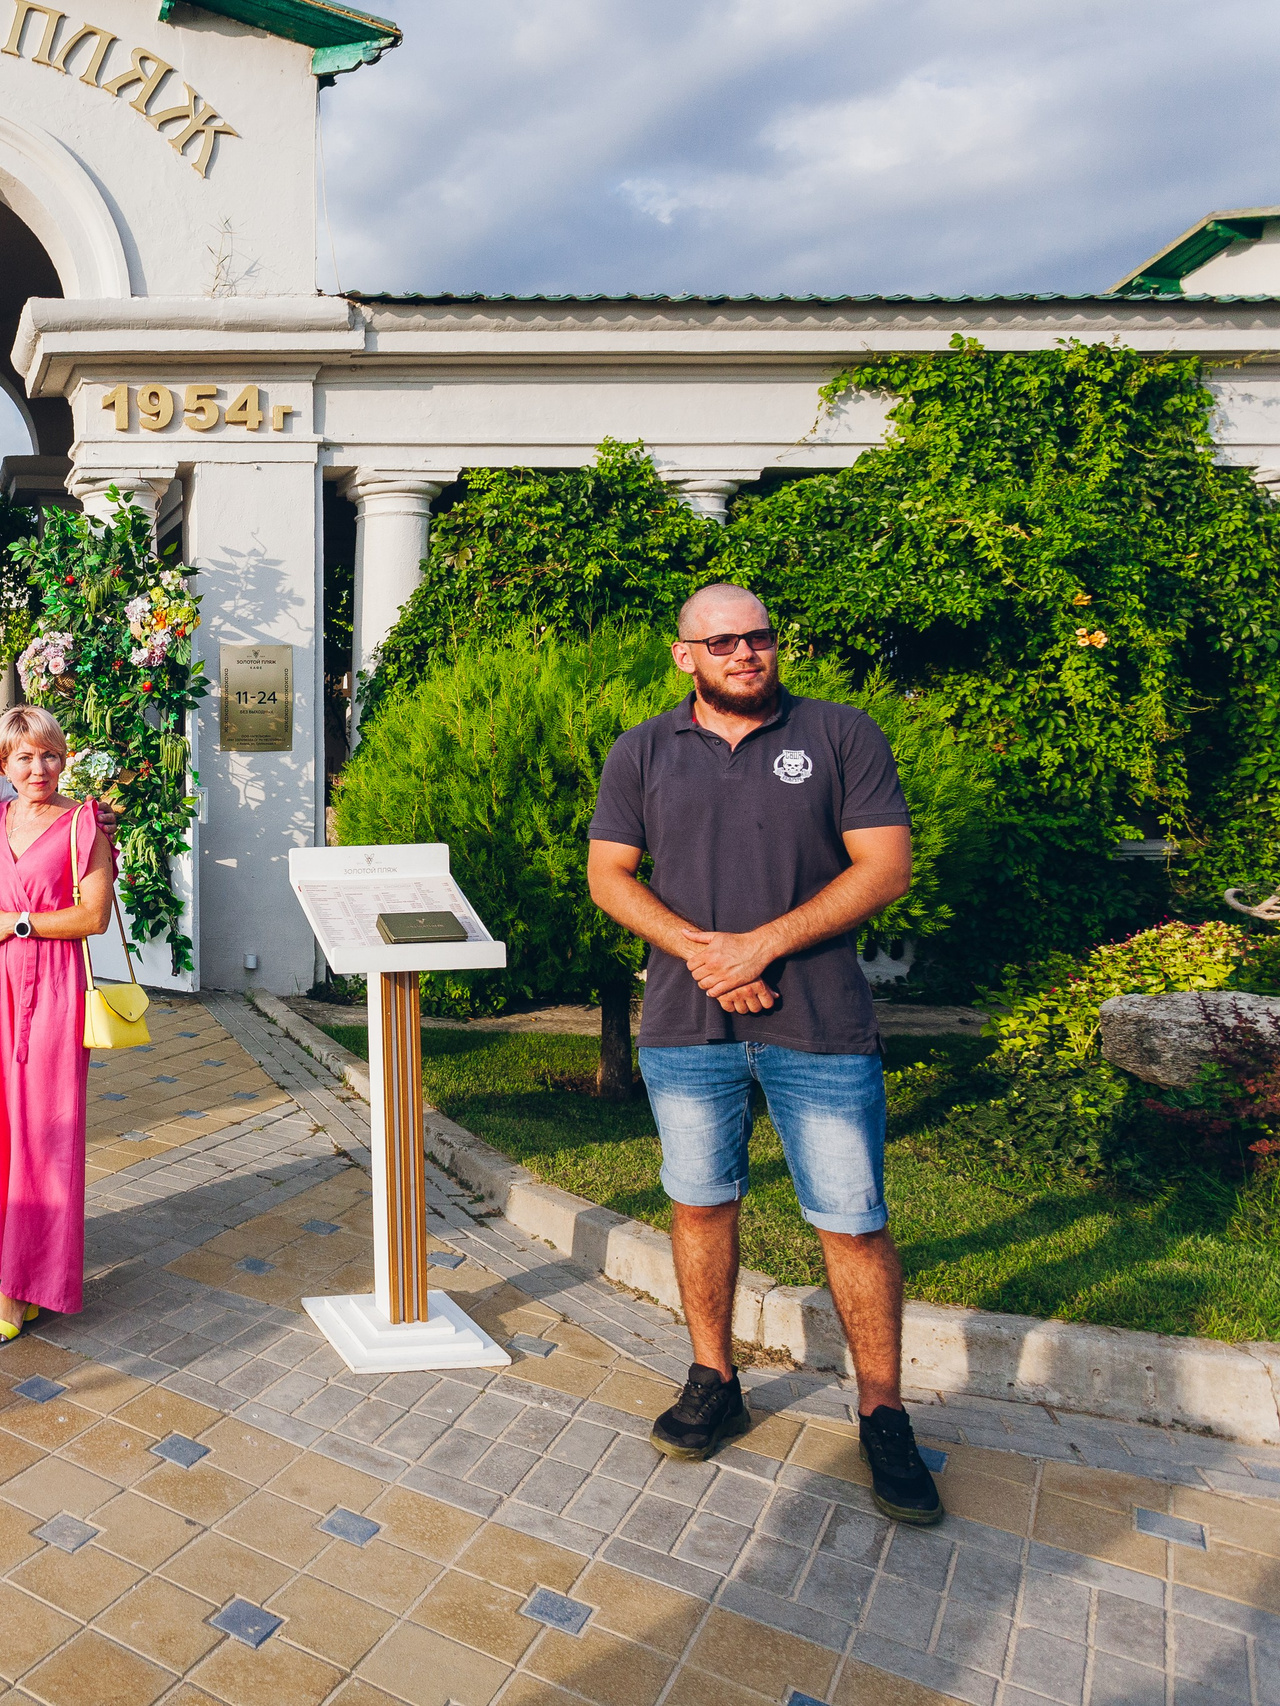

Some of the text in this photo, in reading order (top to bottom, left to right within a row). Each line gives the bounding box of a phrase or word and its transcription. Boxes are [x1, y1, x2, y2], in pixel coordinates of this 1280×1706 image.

[0, 0, 239, 179] ПЛЯЖ
[102, 383, 294, 431] 1954г
[235, 691, 277, 704] 11-24
[343, 867, 376, 875] ЗОЛОТОЙ
